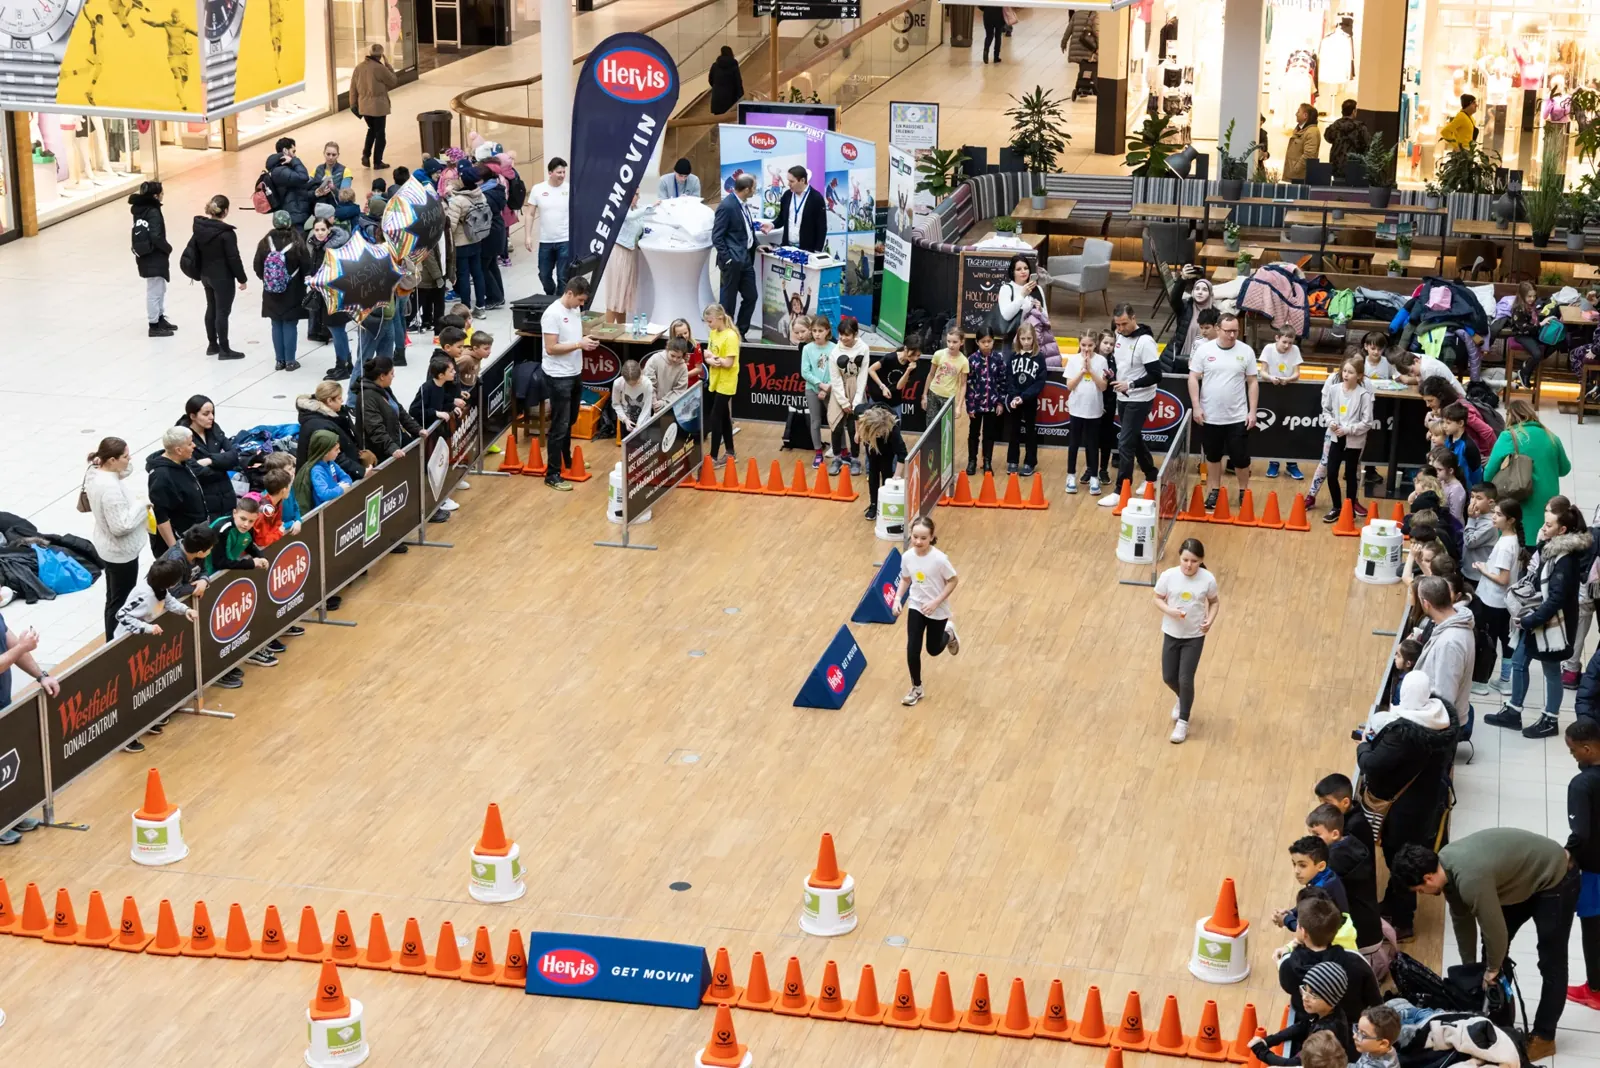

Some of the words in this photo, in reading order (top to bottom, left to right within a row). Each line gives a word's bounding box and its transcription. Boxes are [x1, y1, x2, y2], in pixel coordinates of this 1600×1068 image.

[603, 58, 666, 92] Hervis
[751, 134, 775, 147] Hervis
[965, 290, 984, 302] HOLY
[584, 355, 614, 375] rvis
[745, 362, 807, 391] Westfie
[1011, 356, 1040, 379] YALE
[751, 393, 780, 405] DONAU
[781, 394, 809, 408] ZENTR
[339, 521, 363, 548] motion
[383, 497, 397, 516] kids
[273, 554, 307, 592] Hervis
[216, 592, 253, 631] Hervis
[127, 629, 185, 690] Westfield
[132, 686, 155, 710] DONAU
[155, 663, 183, 697] ZENTRUM
[57, 673, 121, 740] Westfield
[63, 733, 87, 759] DONAU
[88, 709, 118, 743] ZENTRUM
[543, 954, 594, 979] Hervis
[611, 966, 639, 977] GET
